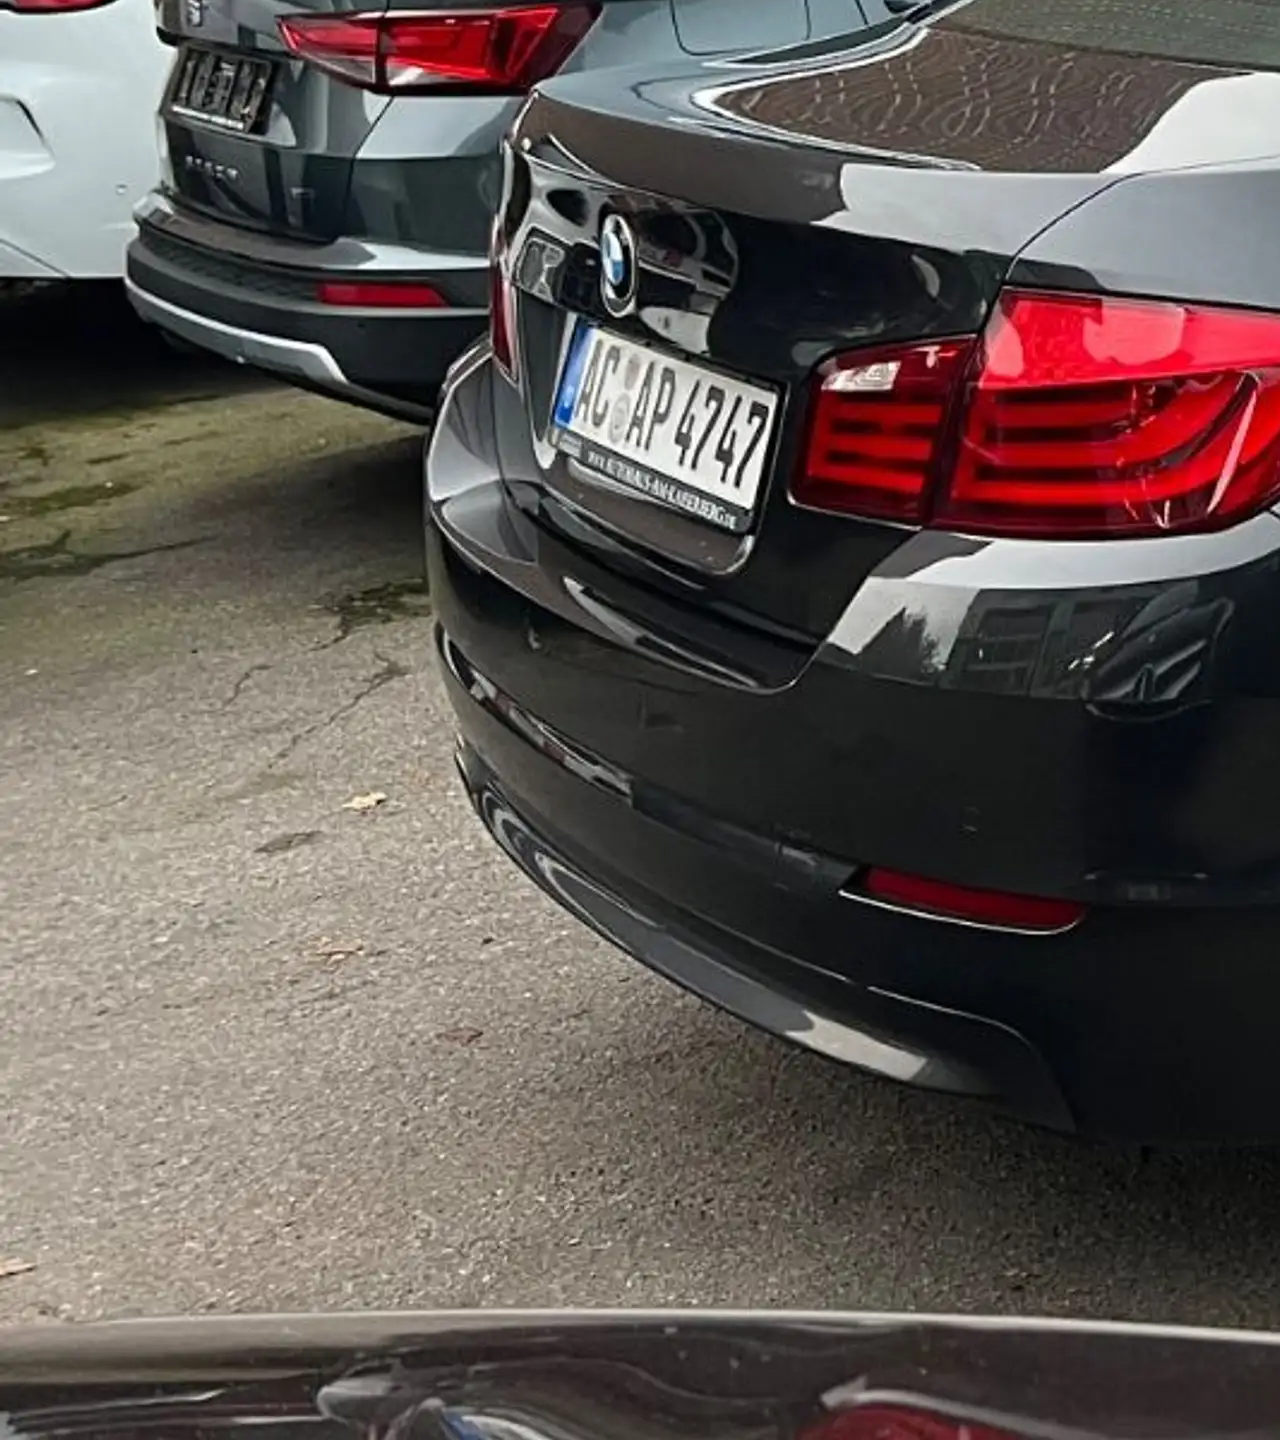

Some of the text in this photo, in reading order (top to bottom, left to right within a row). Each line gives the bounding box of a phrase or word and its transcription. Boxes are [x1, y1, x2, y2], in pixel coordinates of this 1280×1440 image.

[577, 338, 769, 489] AC AP 4747
